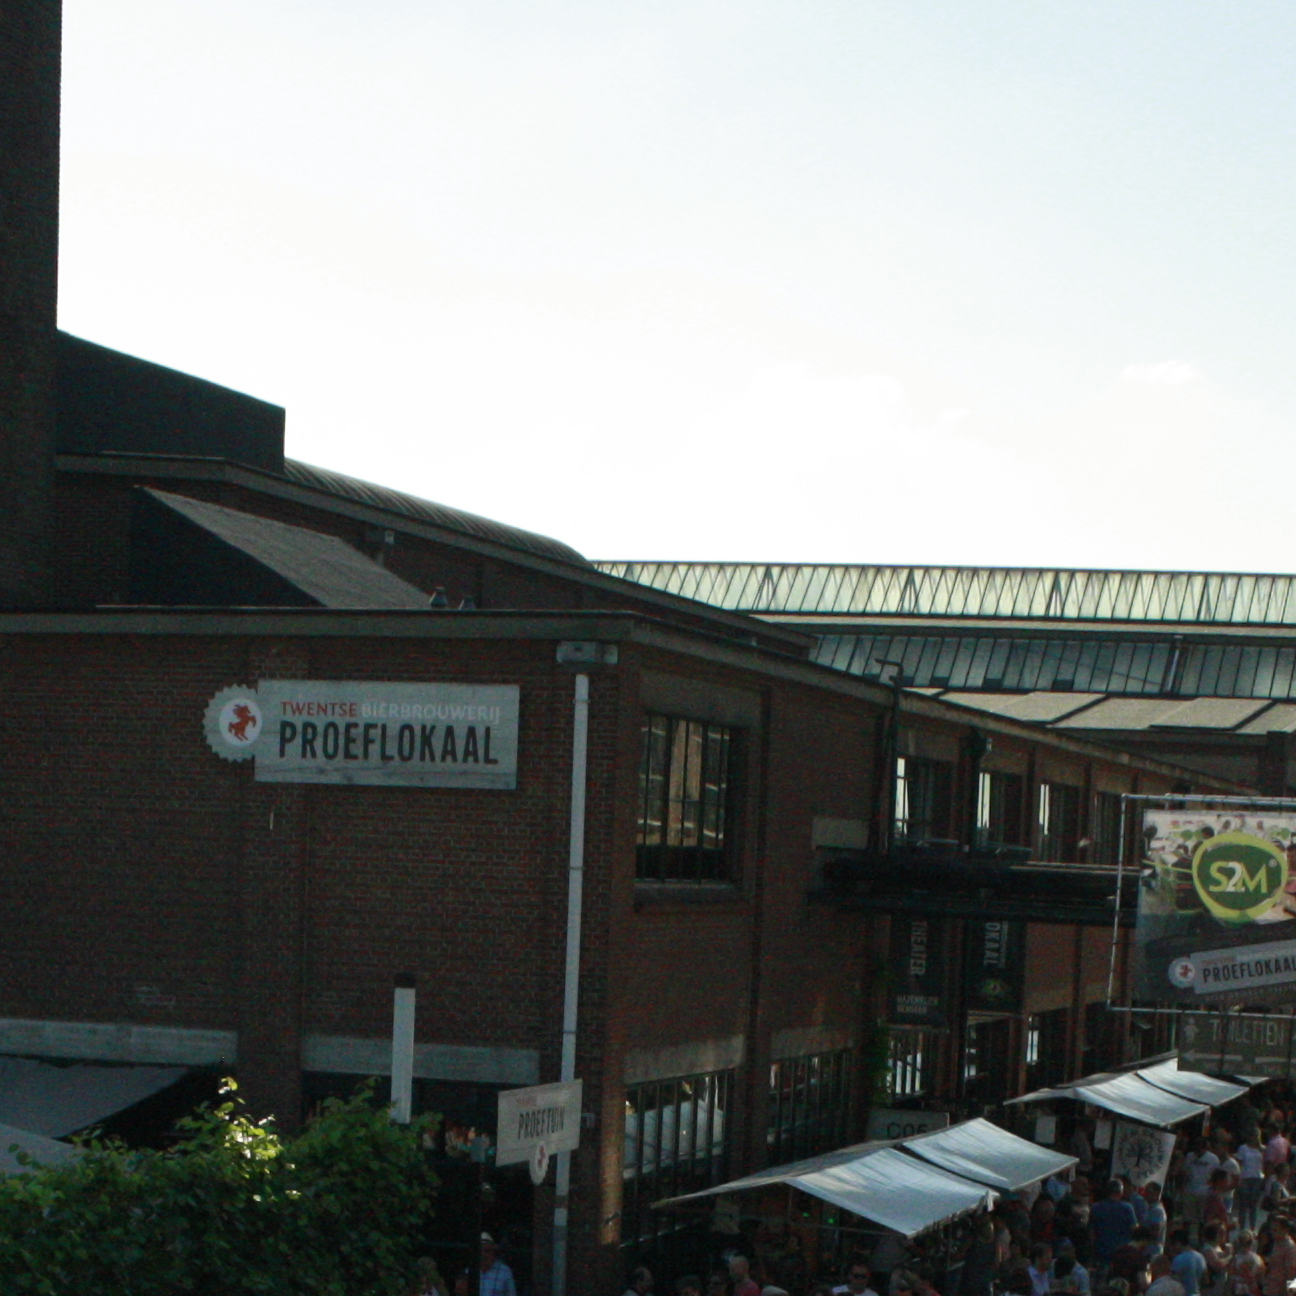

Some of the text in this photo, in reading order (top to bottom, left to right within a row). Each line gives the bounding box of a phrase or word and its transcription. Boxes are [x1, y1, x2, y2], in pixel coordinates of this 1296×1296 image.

[281, 701, 502, 725] TWENTSE BIERBROUWERIJ
[279, 720, 499, 765] PROEFLOKAAL
[1208, 860, 1269, 894] S2M
